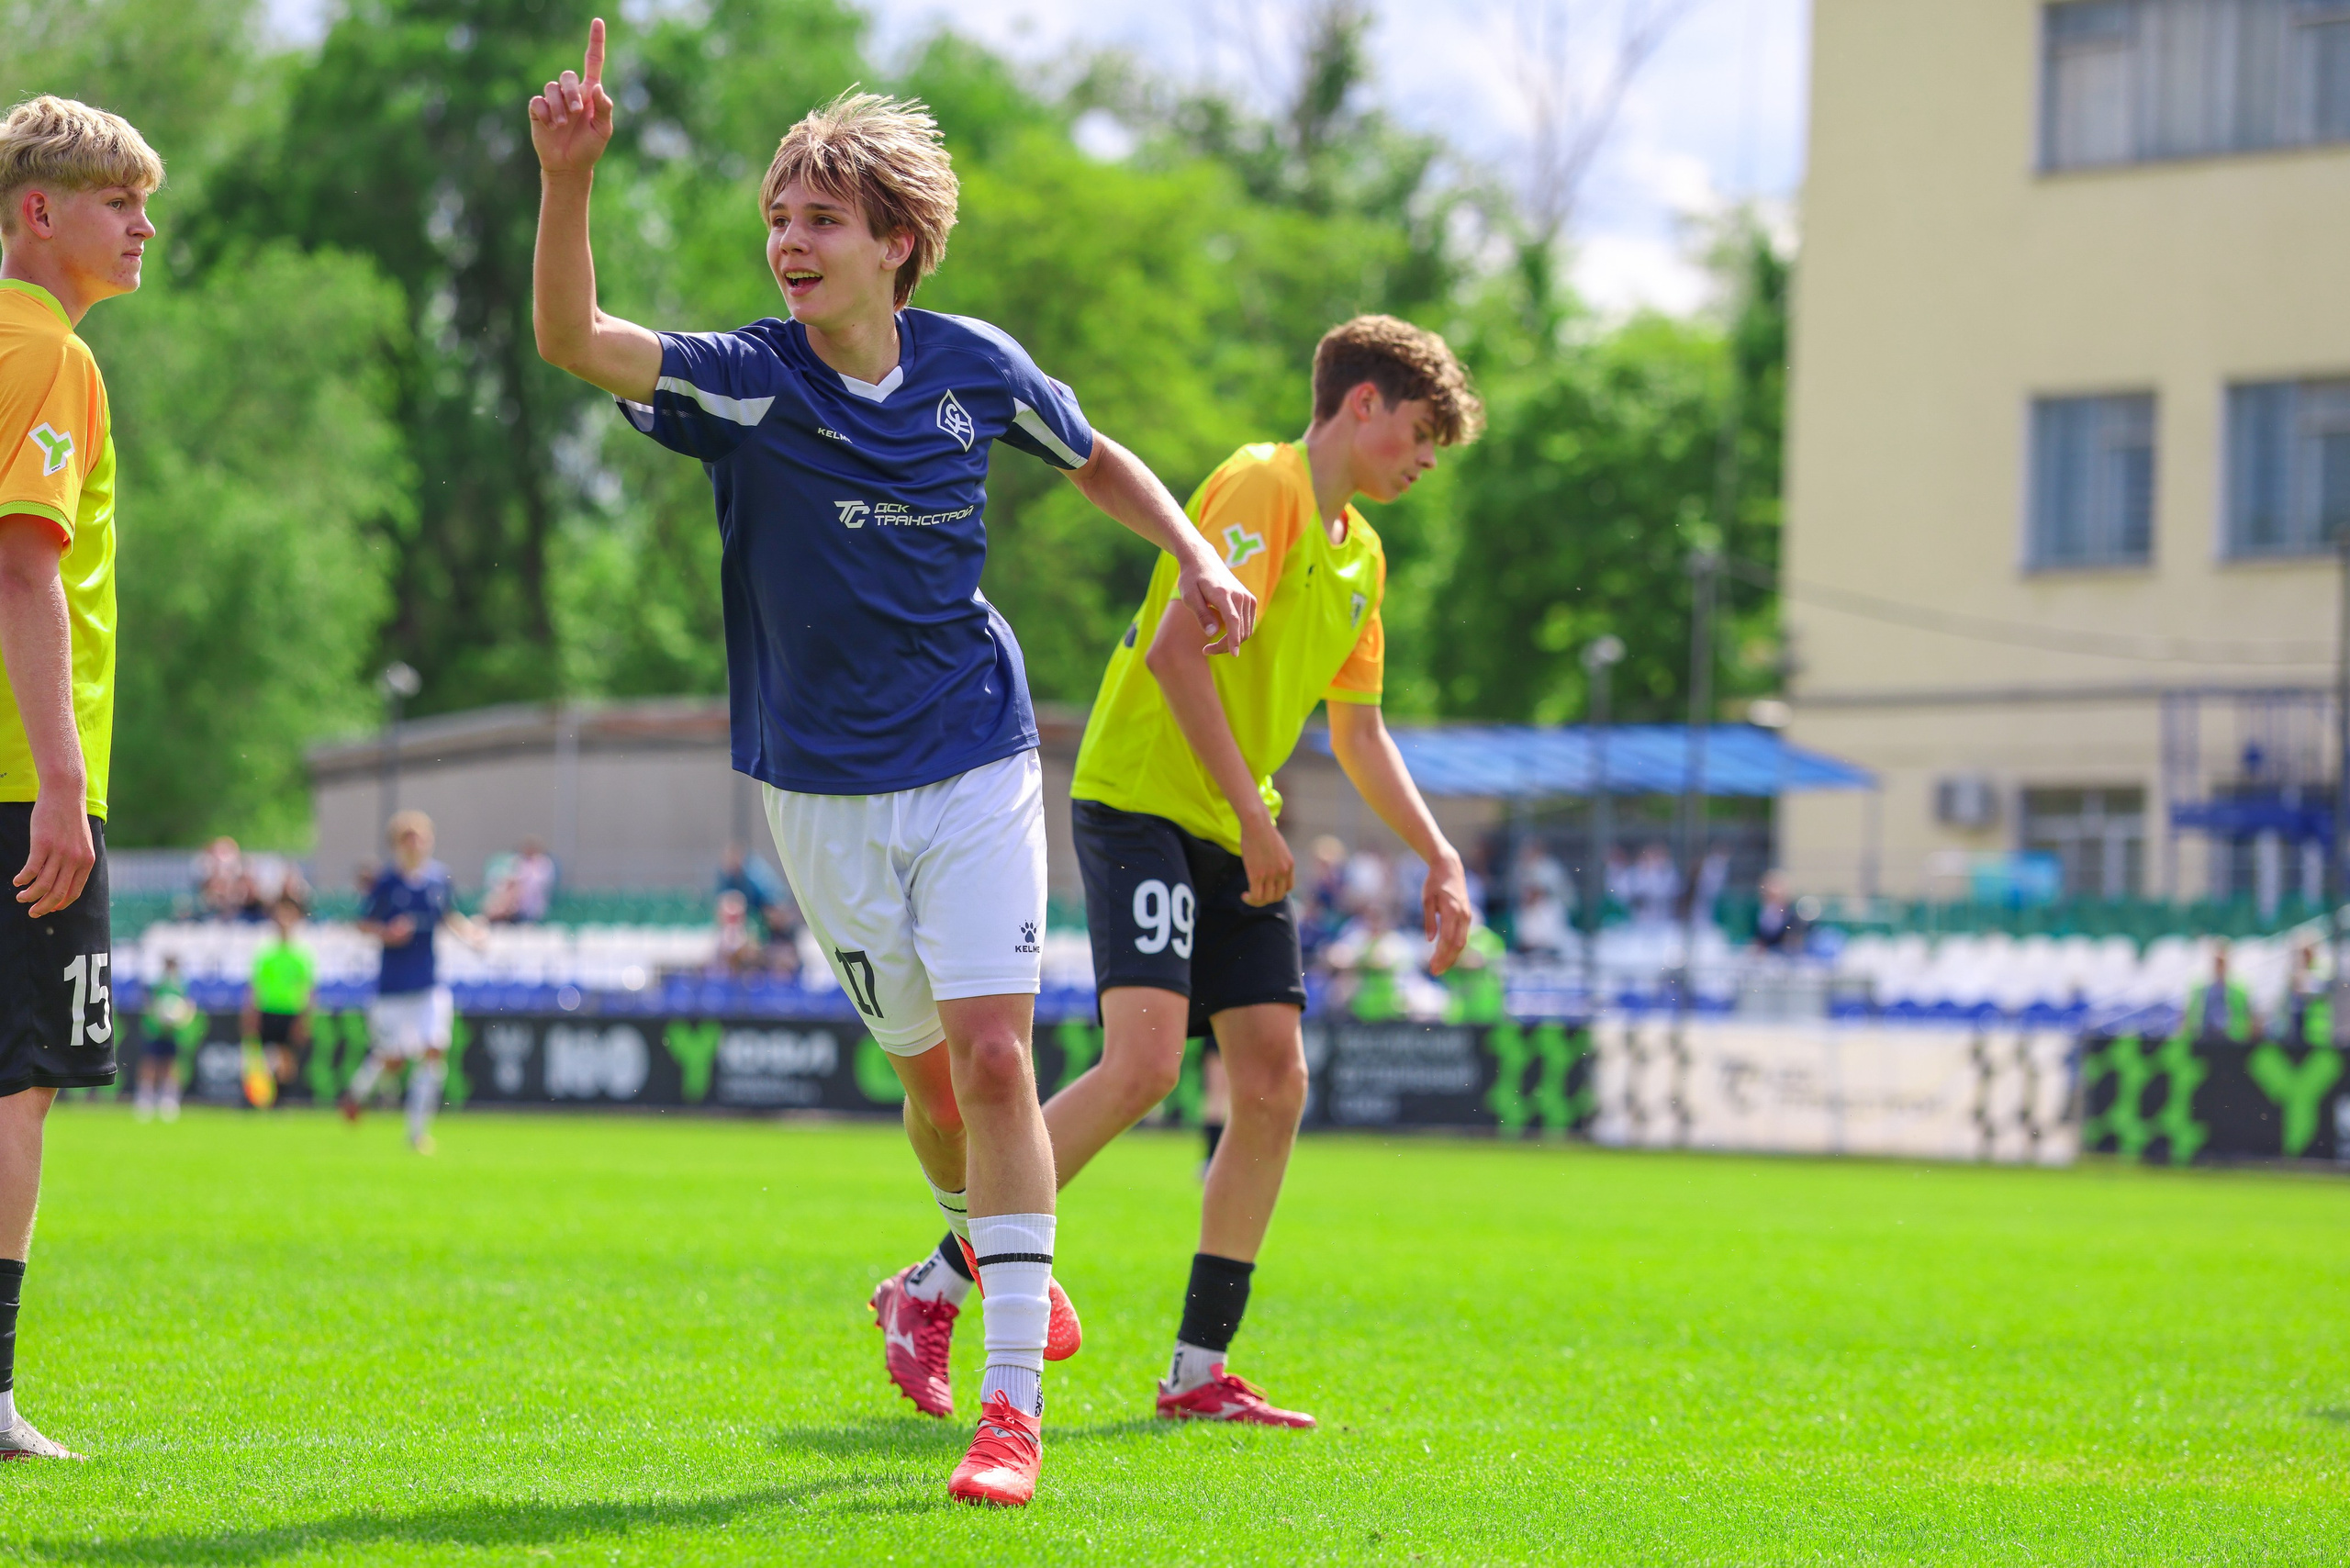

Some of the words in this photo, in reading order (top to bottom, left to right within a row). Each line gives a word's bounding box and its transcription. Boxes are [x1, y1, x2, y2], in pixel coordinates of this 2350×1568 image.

[817, 427, 853, 444] KELM
[874, 502, 910, 513] ДСК
[874, 505, 975, 526] ТРАНССТРОЙ
[1132, 879, 1194, 959] 99
[63, 952, 112, 1047] 15
[834, 946, 884, 1018] 17
